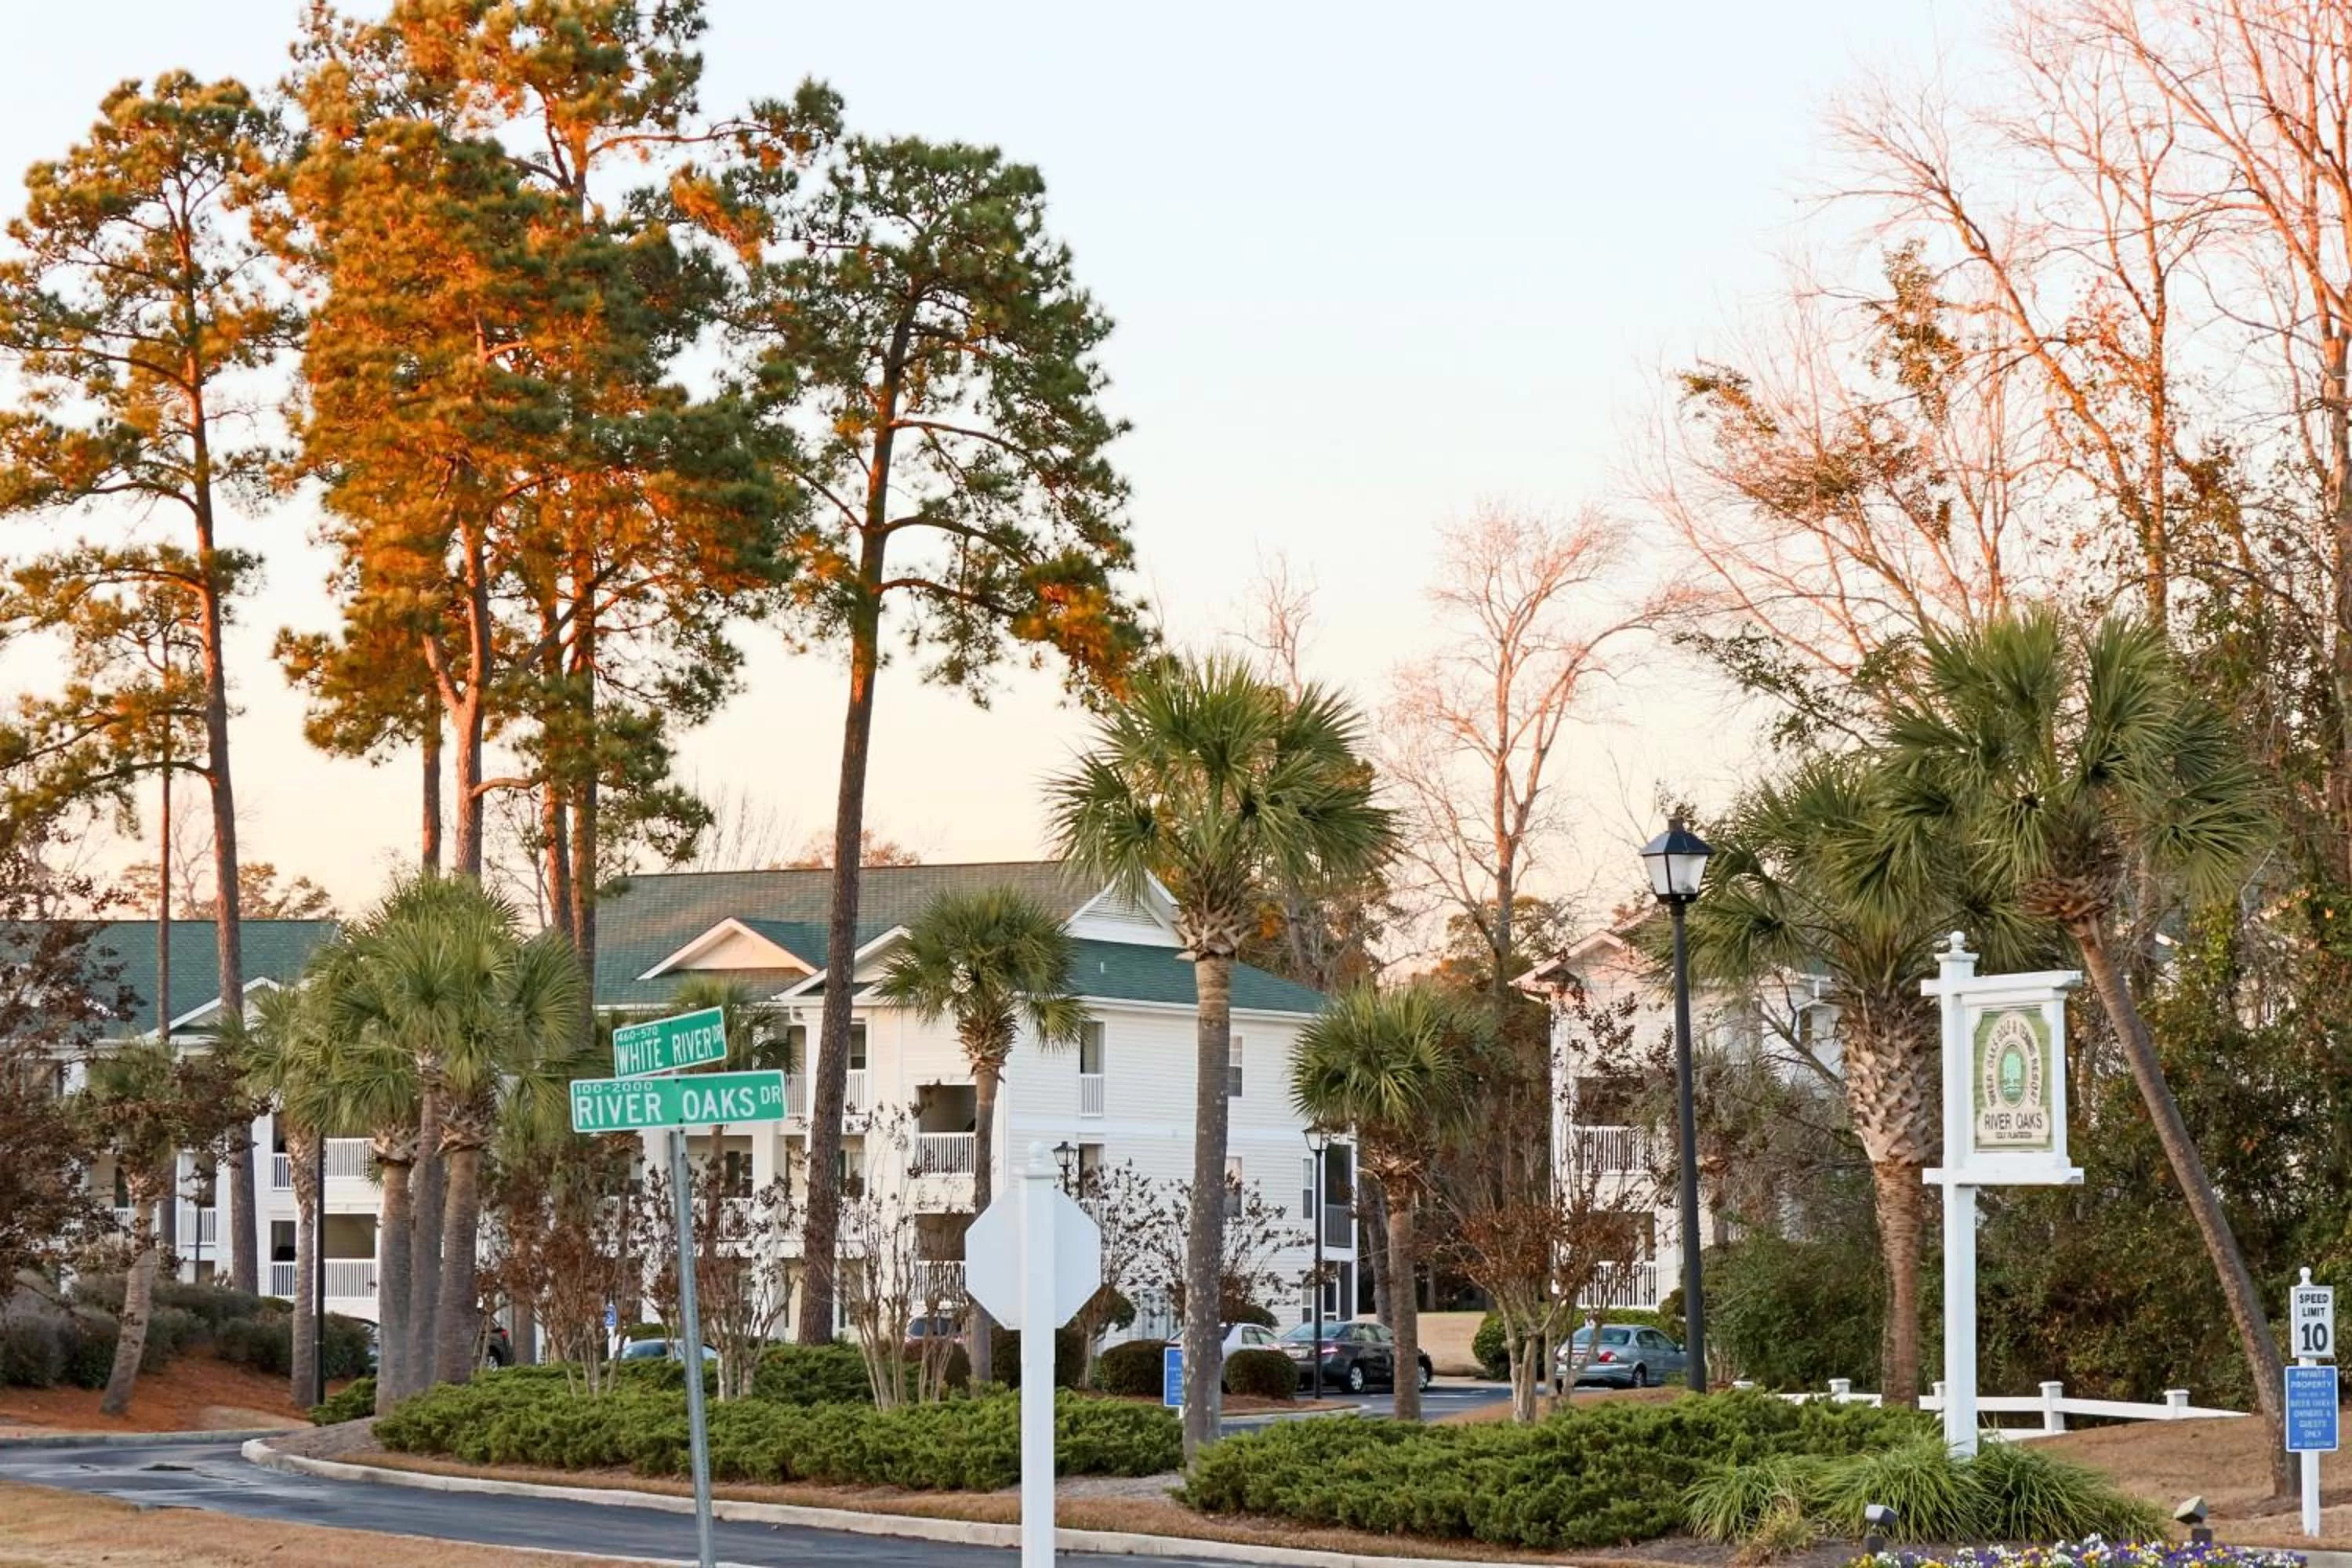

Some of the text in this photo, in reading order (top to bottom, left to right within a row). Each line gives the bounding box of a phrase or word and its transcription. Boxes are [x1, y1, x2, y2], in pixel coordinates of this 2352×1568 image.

[618, 1024, 723, 1075] WHITE RIVER DR
[576, 1082, 653, 1094] 100-2000
[576, 1085, 782, 1127] RIVER OAKS DR
[1984, 1112, 2043, 1130] RIVER OAKS
[2299, 1294, 2328, 1304] SPEED
[2302, 1307, 2325, 1317] LIMIT
[2301, 1323, 2328, 1352] 10
[2290, 1380, 2332, 1389] PROPERTY
